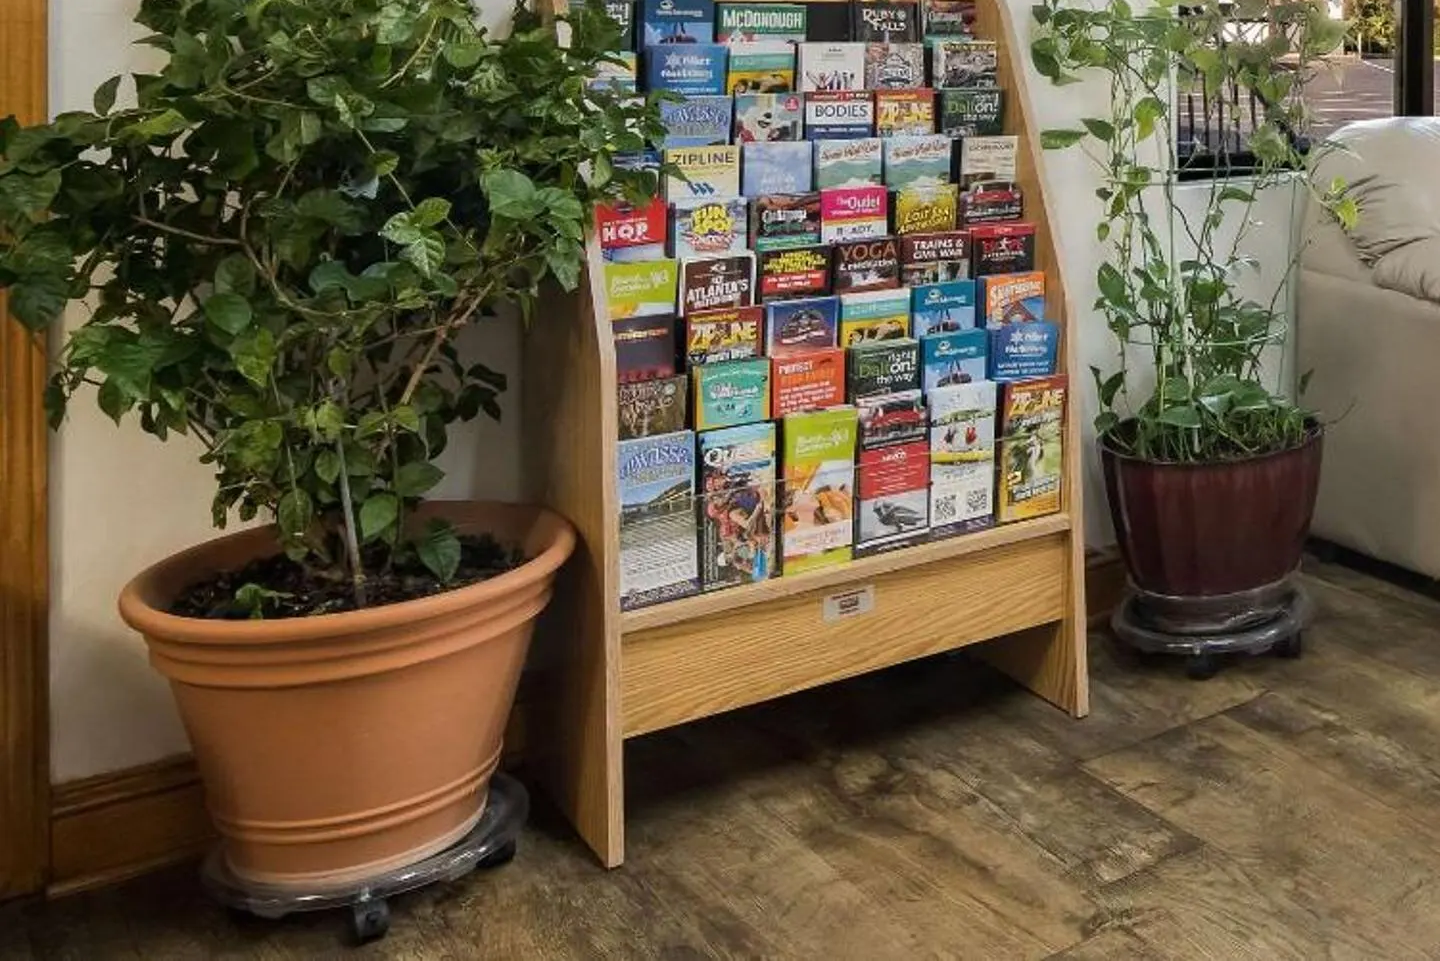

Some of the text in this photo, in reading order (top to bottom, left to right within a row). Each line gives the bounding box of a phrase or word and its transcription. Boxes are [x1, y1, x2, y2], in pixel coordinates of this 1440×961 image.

[871, 18, 907, 31] FALLS
[815, 104, 869, 118] BODIES
[672, 152, 735, 166] ZIPLINE
[602, 221, 649, 242] HOP
[839, 241, 898, 262] YOGA
[912, 238, 964, 251] TRAINS &
[912, 247, 964, 260] CIVIL WAR
[686, 278, 749, 305] ATLANTA'S
[876, 373, 915, 385] the way
